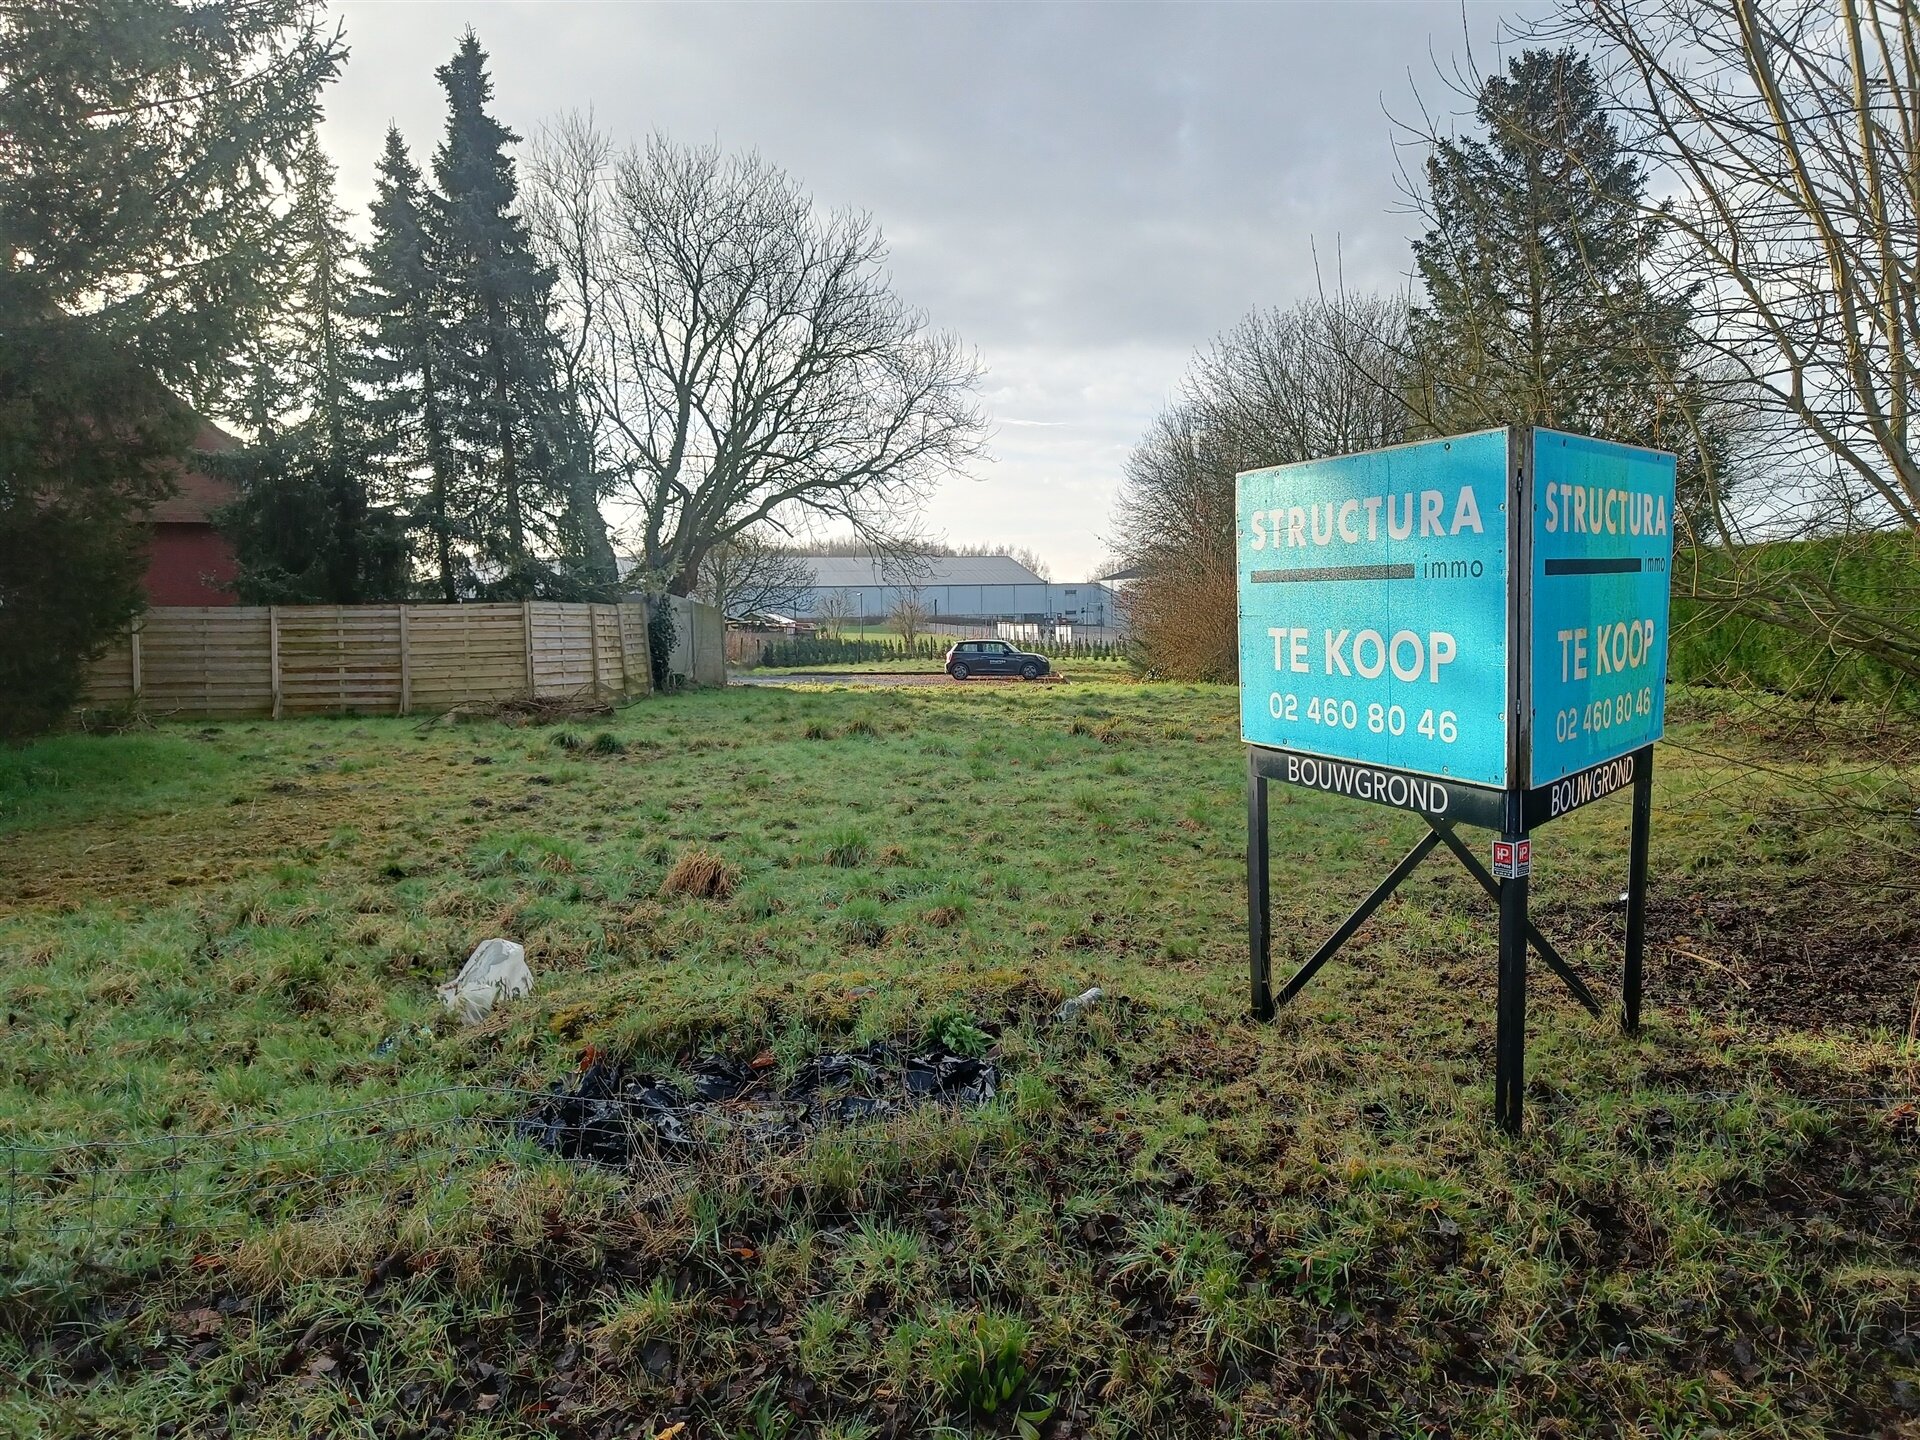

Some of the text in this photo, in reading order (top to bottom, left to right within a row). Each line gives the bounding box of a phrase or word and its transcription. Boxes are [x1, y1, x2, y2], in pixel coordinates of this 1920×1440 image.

[1251, 486, 1483, 551] STRUCTURA
[1545, 482, 1667, 536] STRUCTURA
[1424, 554, 1482, 579] immo
[1644, 550, 1665, 573] immo
[1268, 628, 1456, 683] TE KOOP
[1558, 619, 1654, 683] TE KOOP
[1270, 693, 1458, 743] 02 460 80 46
[1556, 687, 1650, 743] 02 460 80 46
[1288, 756, 1448, 814] BOUWGROND
[1552, 756, 1633, 816] BOUWGROND
